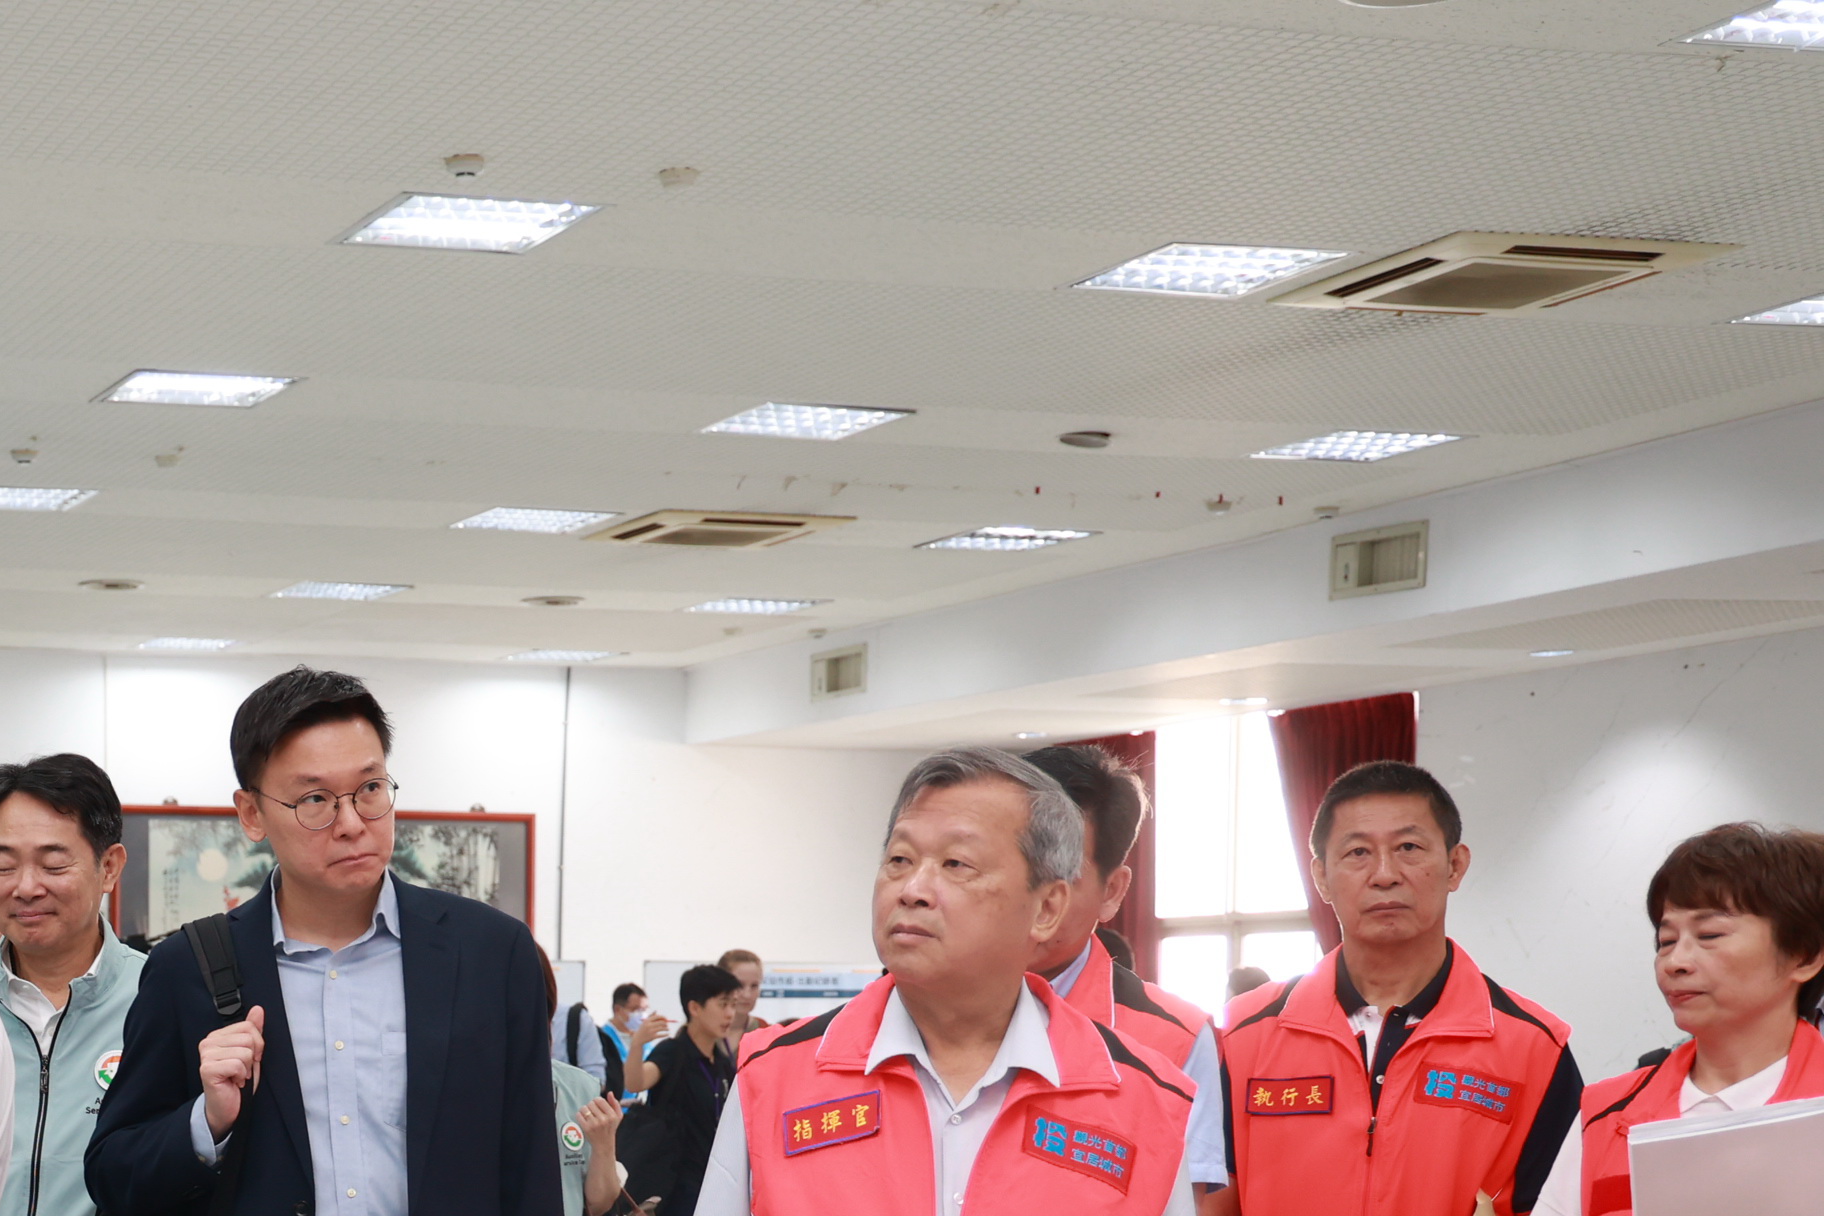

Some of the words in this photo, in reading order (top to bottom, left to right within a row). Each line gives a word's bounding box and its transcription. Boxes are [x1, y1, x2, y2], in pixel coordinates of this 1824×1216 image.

[1253, 1085, 1324, 1107] 執行長
[793, 1104, 870, 1142] 指揮官
[1070, 1148, 1125, 1179] 宜居城市
